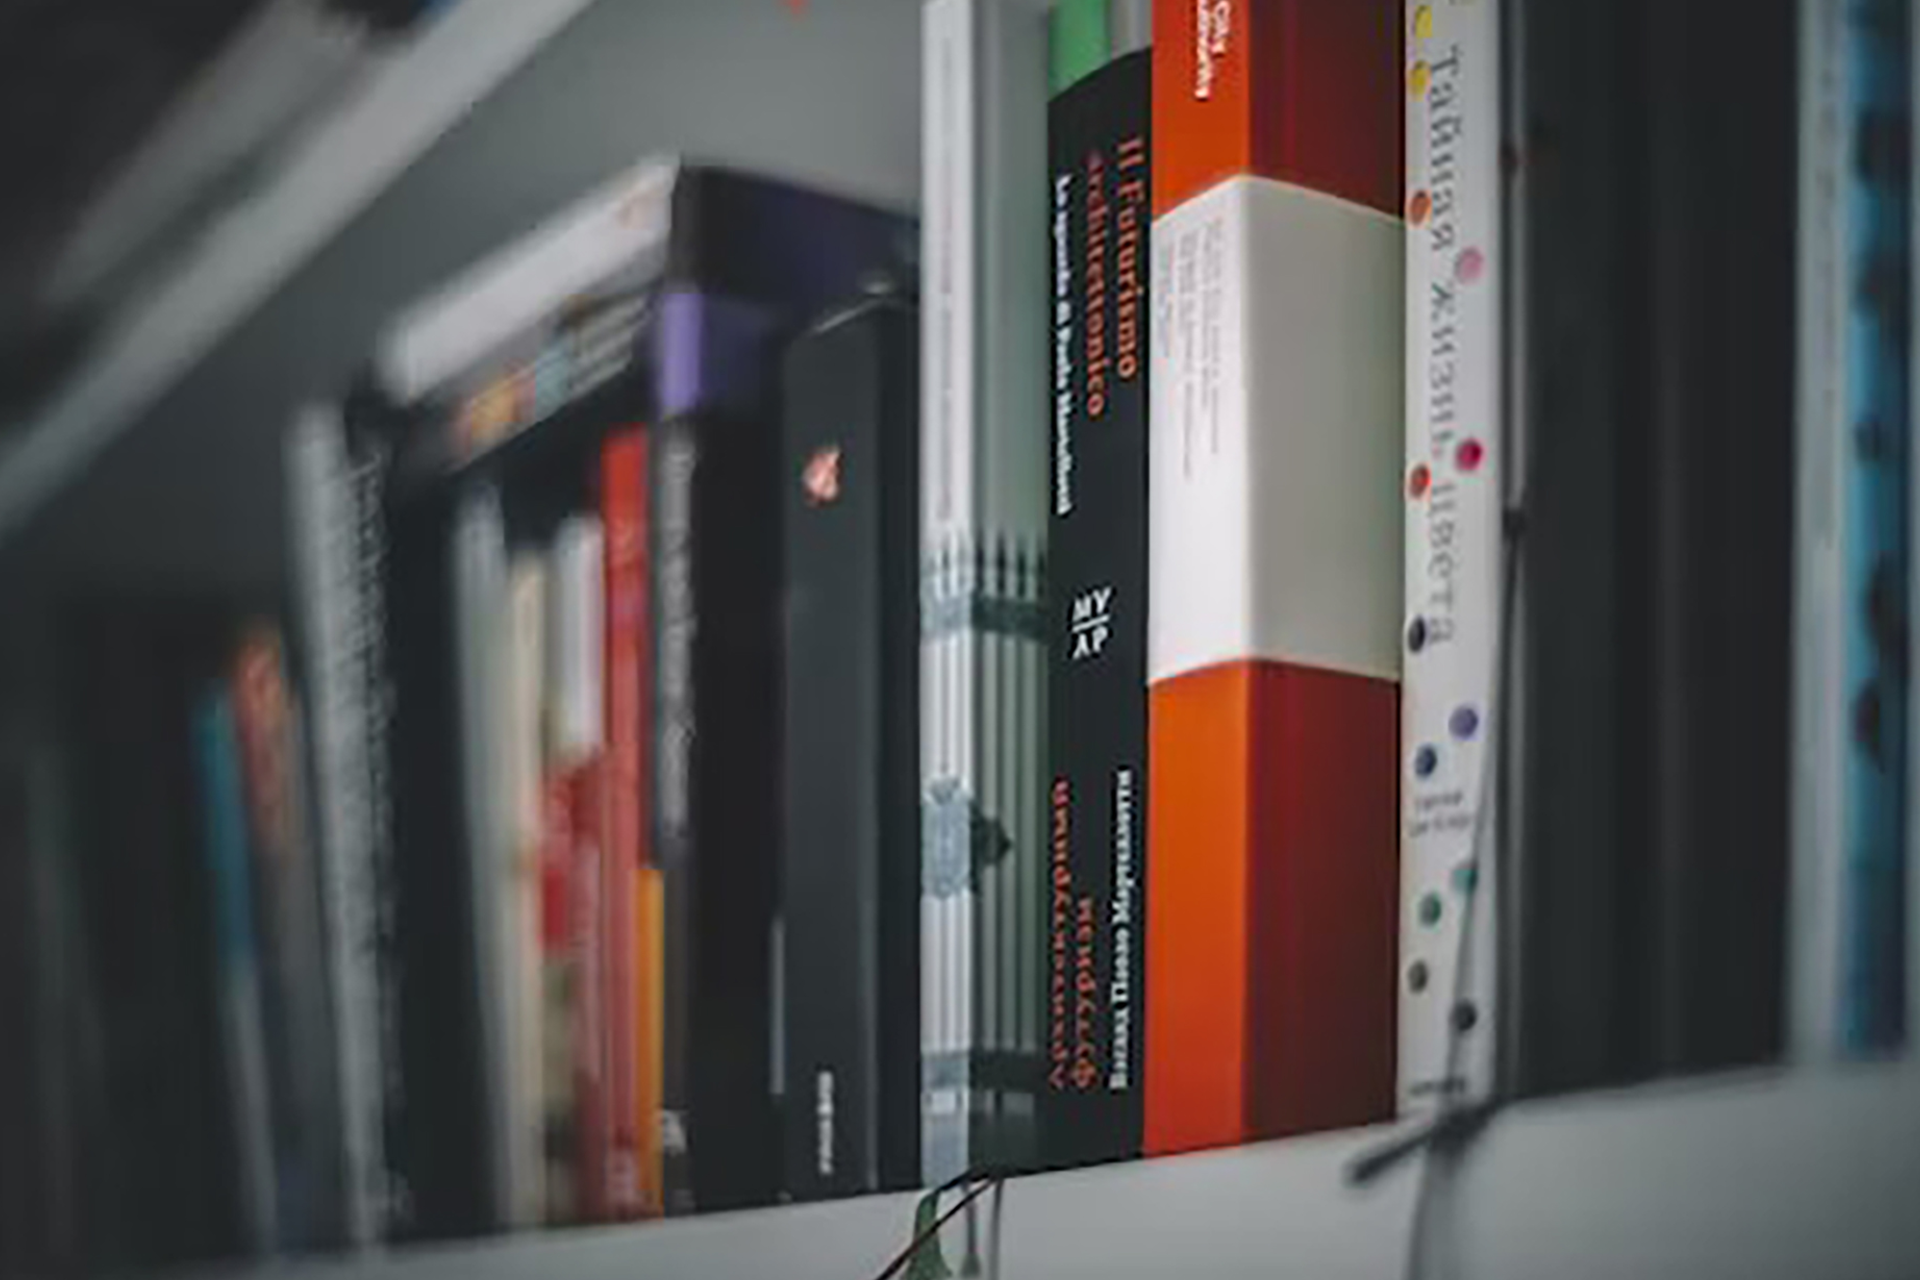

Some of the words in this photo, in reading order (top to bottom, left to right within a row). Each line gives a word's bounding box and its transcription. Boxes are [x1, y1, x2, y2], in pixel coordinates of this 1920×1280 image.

[1117, 138, 1144, 168] Il
[1431, 45, 1461, 250] Тайная
[1117, 178, 1145, 378] Futurismo
[1431, 280, 1455, 458] жизнь
[1428, 482, 1455, 643] цвета
